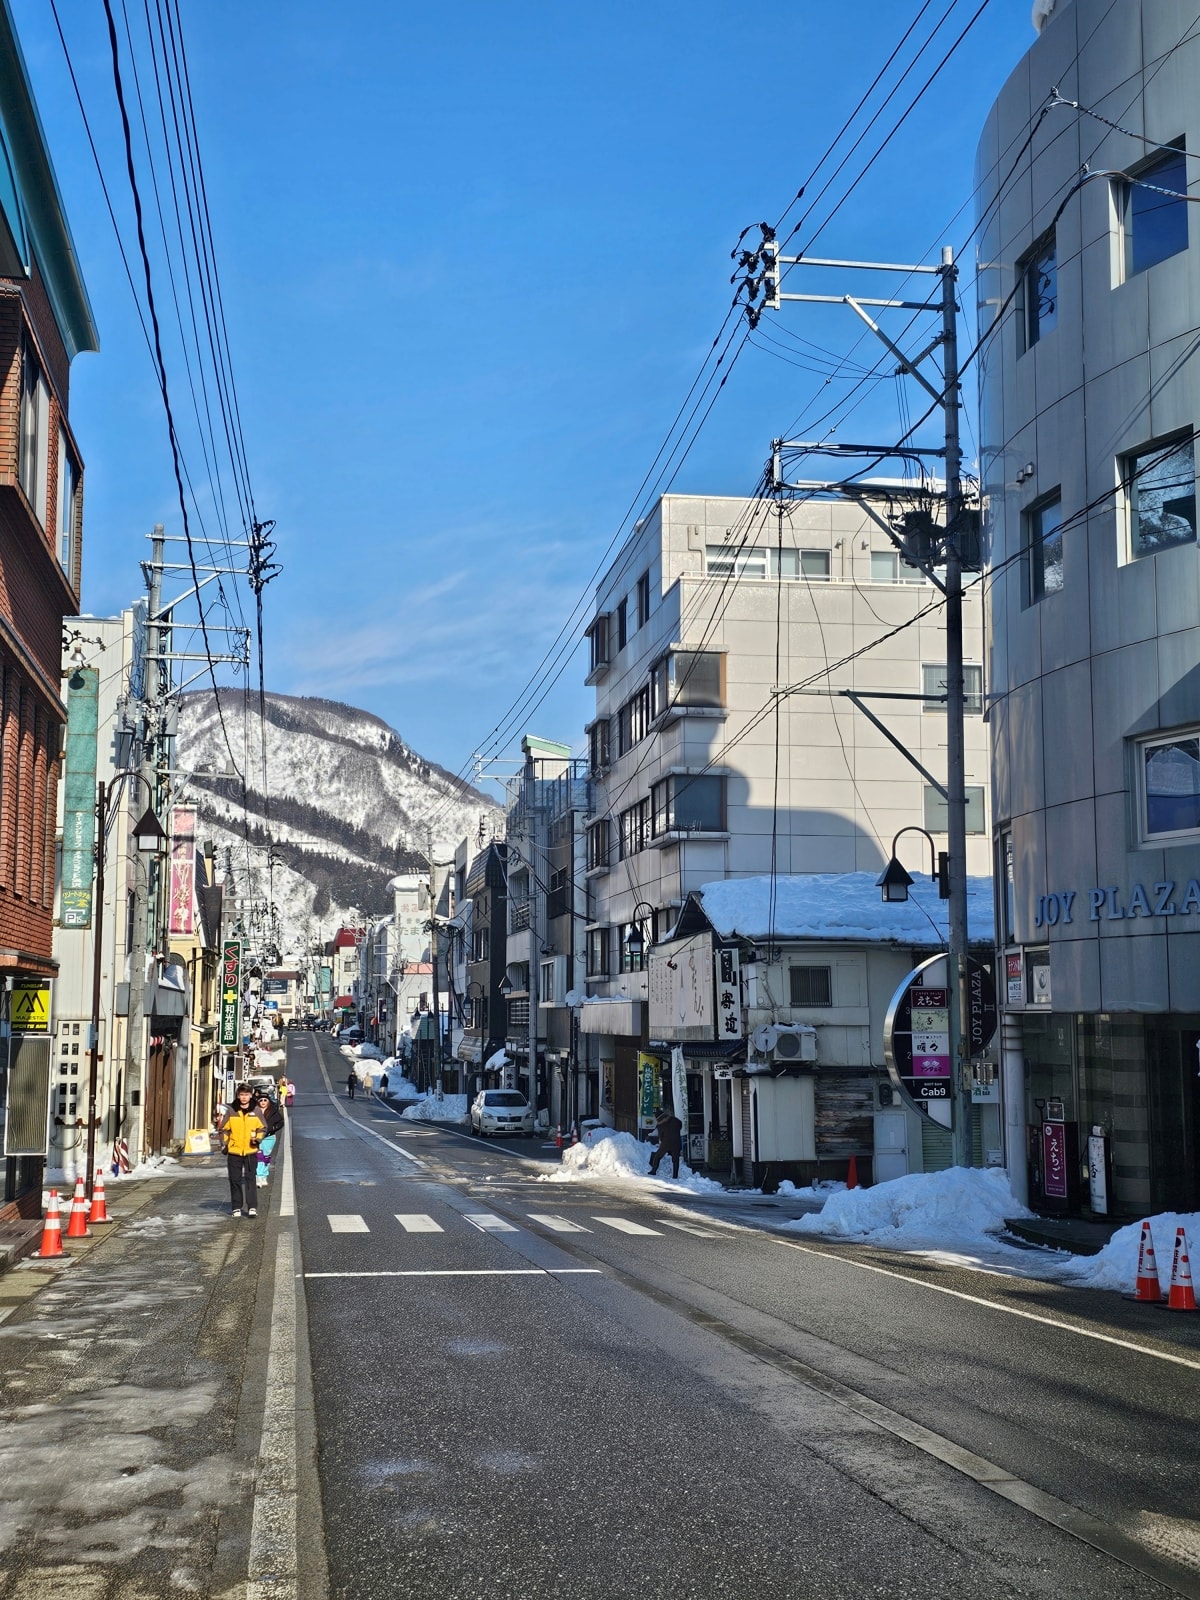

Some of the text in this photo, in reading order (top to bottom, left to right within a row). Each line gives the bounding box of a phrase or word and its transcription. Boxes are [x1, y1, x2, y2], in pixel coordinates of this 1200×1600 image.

[1034, 879, 1200, 927] JOY PLAZA
[224, 945, 239, 988] くすり
[917, 977, 922, 985] 4
[721, 989, 738, 1034] 寄道
[905, 1007, 911, 1015] 3
[917, 995, 942, 1006] えちご
[971, 970, 982, 1045] JOY PLAZA
[223, 1005, 235, 1040] 和光薬品
[906, 1052, 912, 1060] 2
[920, 1087, 946, 1097] Cab9
[1050, 1138, 1061, 1180] えちご
